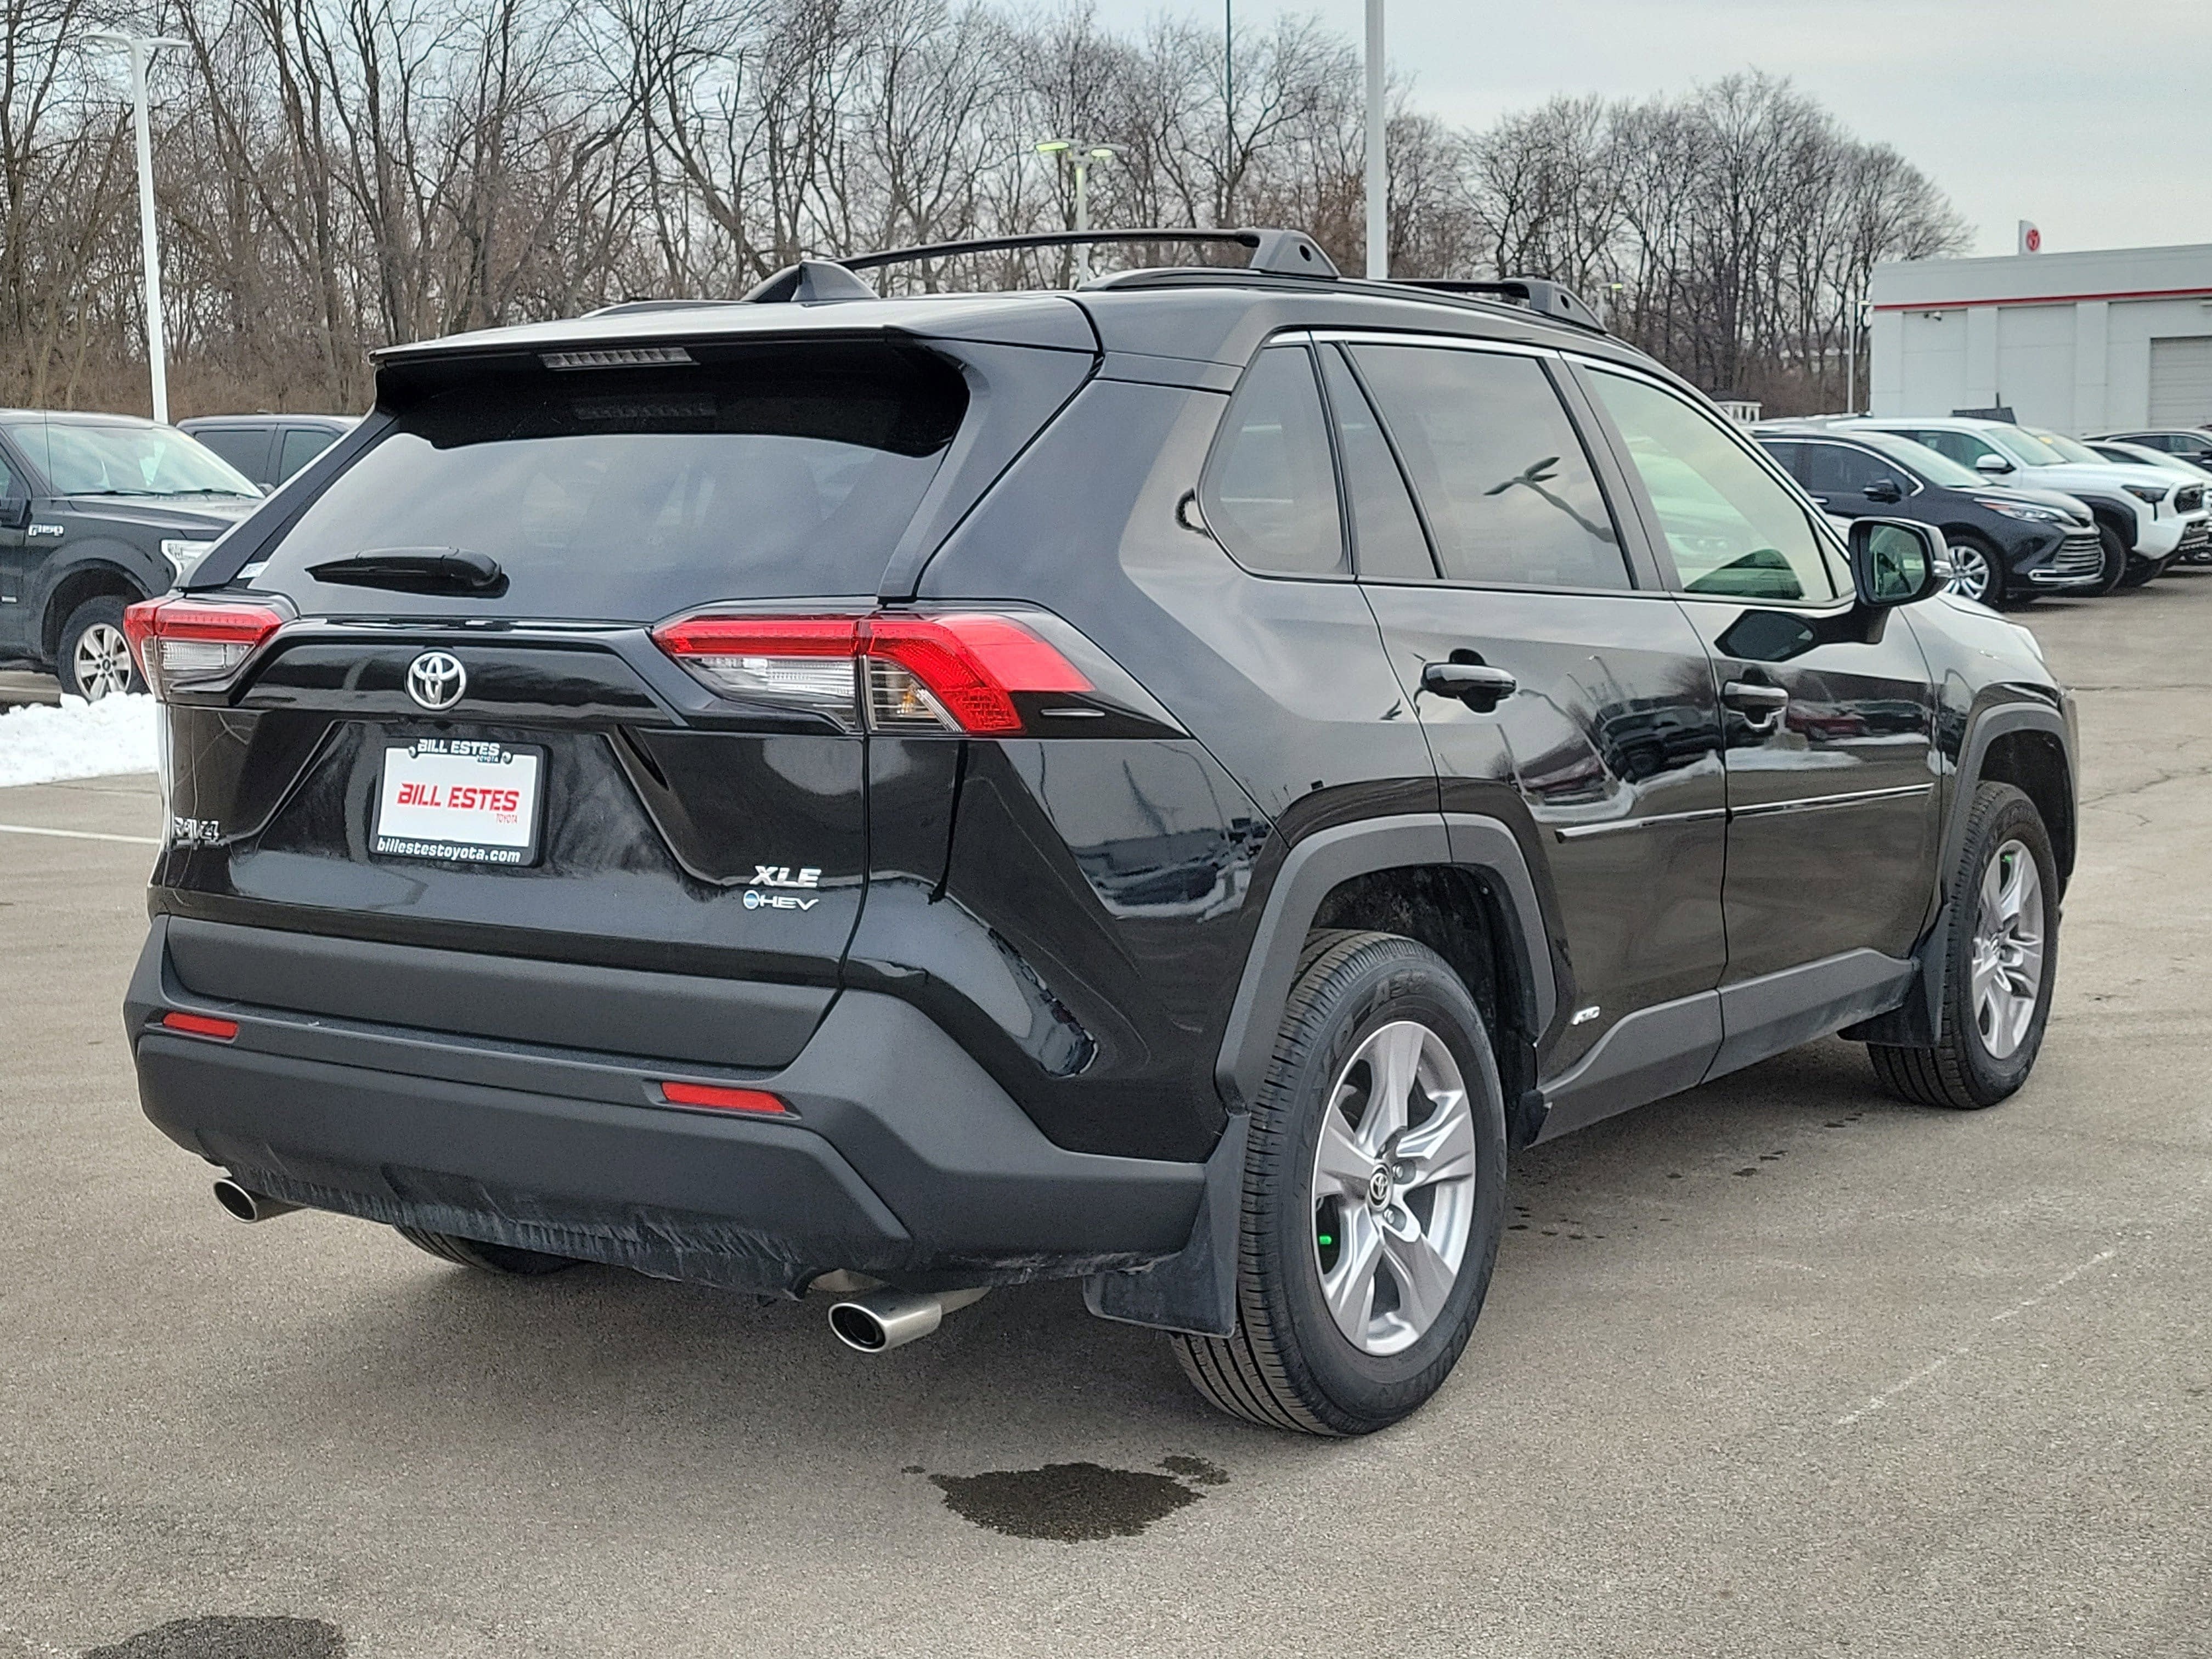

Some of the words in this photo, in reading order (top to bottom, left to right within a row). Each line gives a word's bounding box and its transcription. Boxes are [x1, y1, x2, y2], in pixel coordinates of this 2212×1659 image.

[417, 739, 447, 753] BILL
[451, 741, 500, 755] ESTES
[397, 783, 441, 806] BILL
[447, 787, 520, 812] ESTES
[495, 813, 517, 823] TOYOTA
[377, 837, 521, 862] billestestoyota.com
[749, 865, 822, 888] XLE
